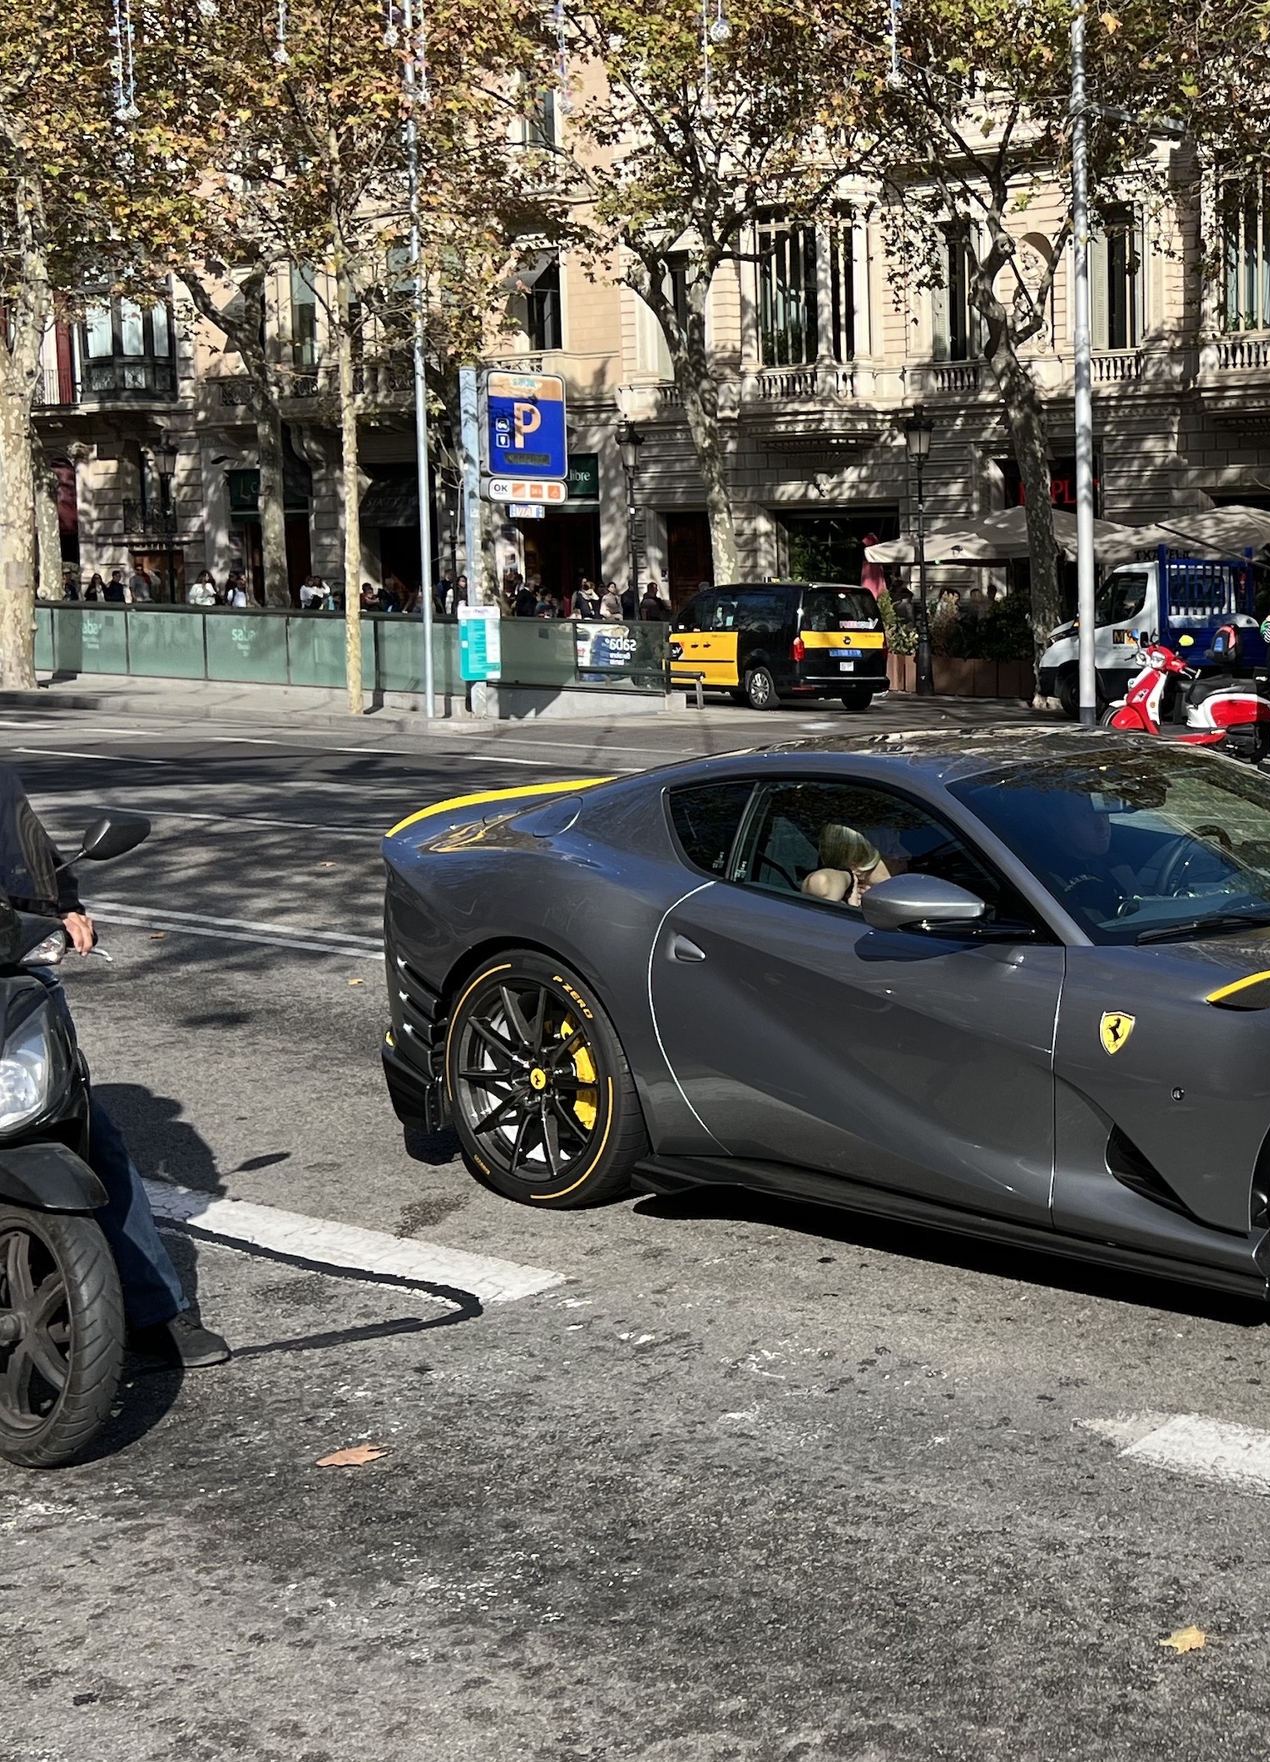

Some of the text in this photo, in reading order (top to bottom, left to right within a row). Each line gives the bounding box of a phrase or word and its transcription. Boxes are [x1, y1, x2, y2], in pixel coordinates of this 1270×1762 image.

[514, 402, 541, 448] P
[494, 484, 508, 492] OK
[562, 981, 594, 1019] ZERO
